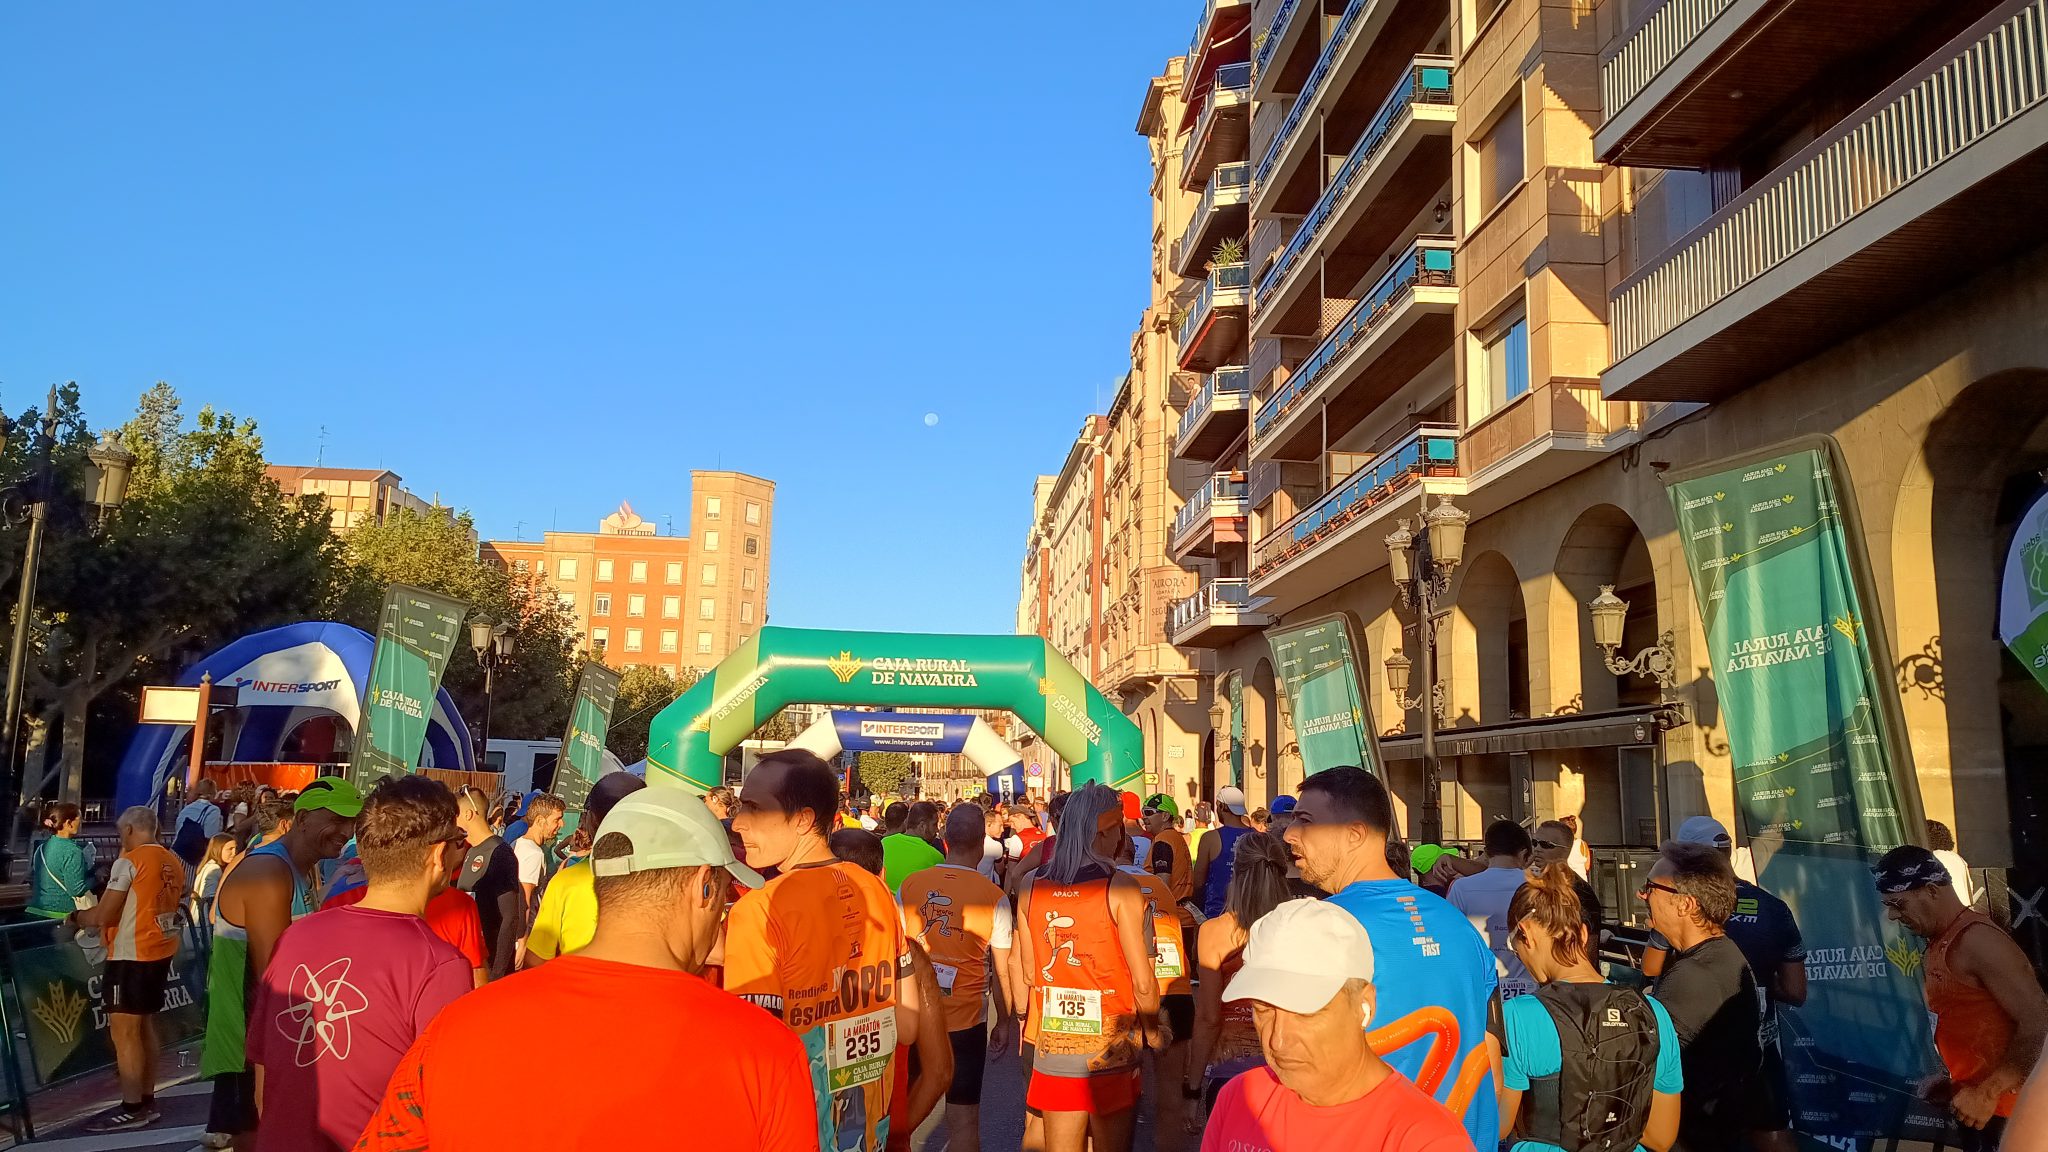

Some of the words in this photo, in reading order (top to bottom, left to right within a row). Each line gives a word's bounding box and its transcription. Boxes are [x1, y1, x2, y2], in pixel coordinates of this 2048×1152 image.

[872, 657, 913, 672] CAJA
[916, 658, 970, 673] RURAL
[252, 679, 341, 693] INTERSPORT
[872, 672, 894, 685] DE
[899, 672, 978, 687] NAVARRA
[380, 698, 392, 708] DE
[382, 690, 404, 702] CAJA
[716, 706, 731, 721] DE
[729, 676, 768, 710] NAVARRA
[1058, 694, 1077, 714] CAJA
[1076, 710, 1102, 736] RURAL
[876, 724, 940, 736] INTERSPORT
[1052, 700, 1066, 712] DE
[1064, 711, 1100, 746] NAVARRA
[1422, 943, 1440, 956] FAST
[754, 994, 784, 1011] VALO
[1058, 1001, 1085, 1016] 135
[844, 1027, 851, 1038] LA
[853, 1020, 880, 1035] MARATÓN
[846, 1031, 880, 1060] 235
[853, 1065, 868, 1074] CAJA
[853, 1074, 862, 1082] DE
